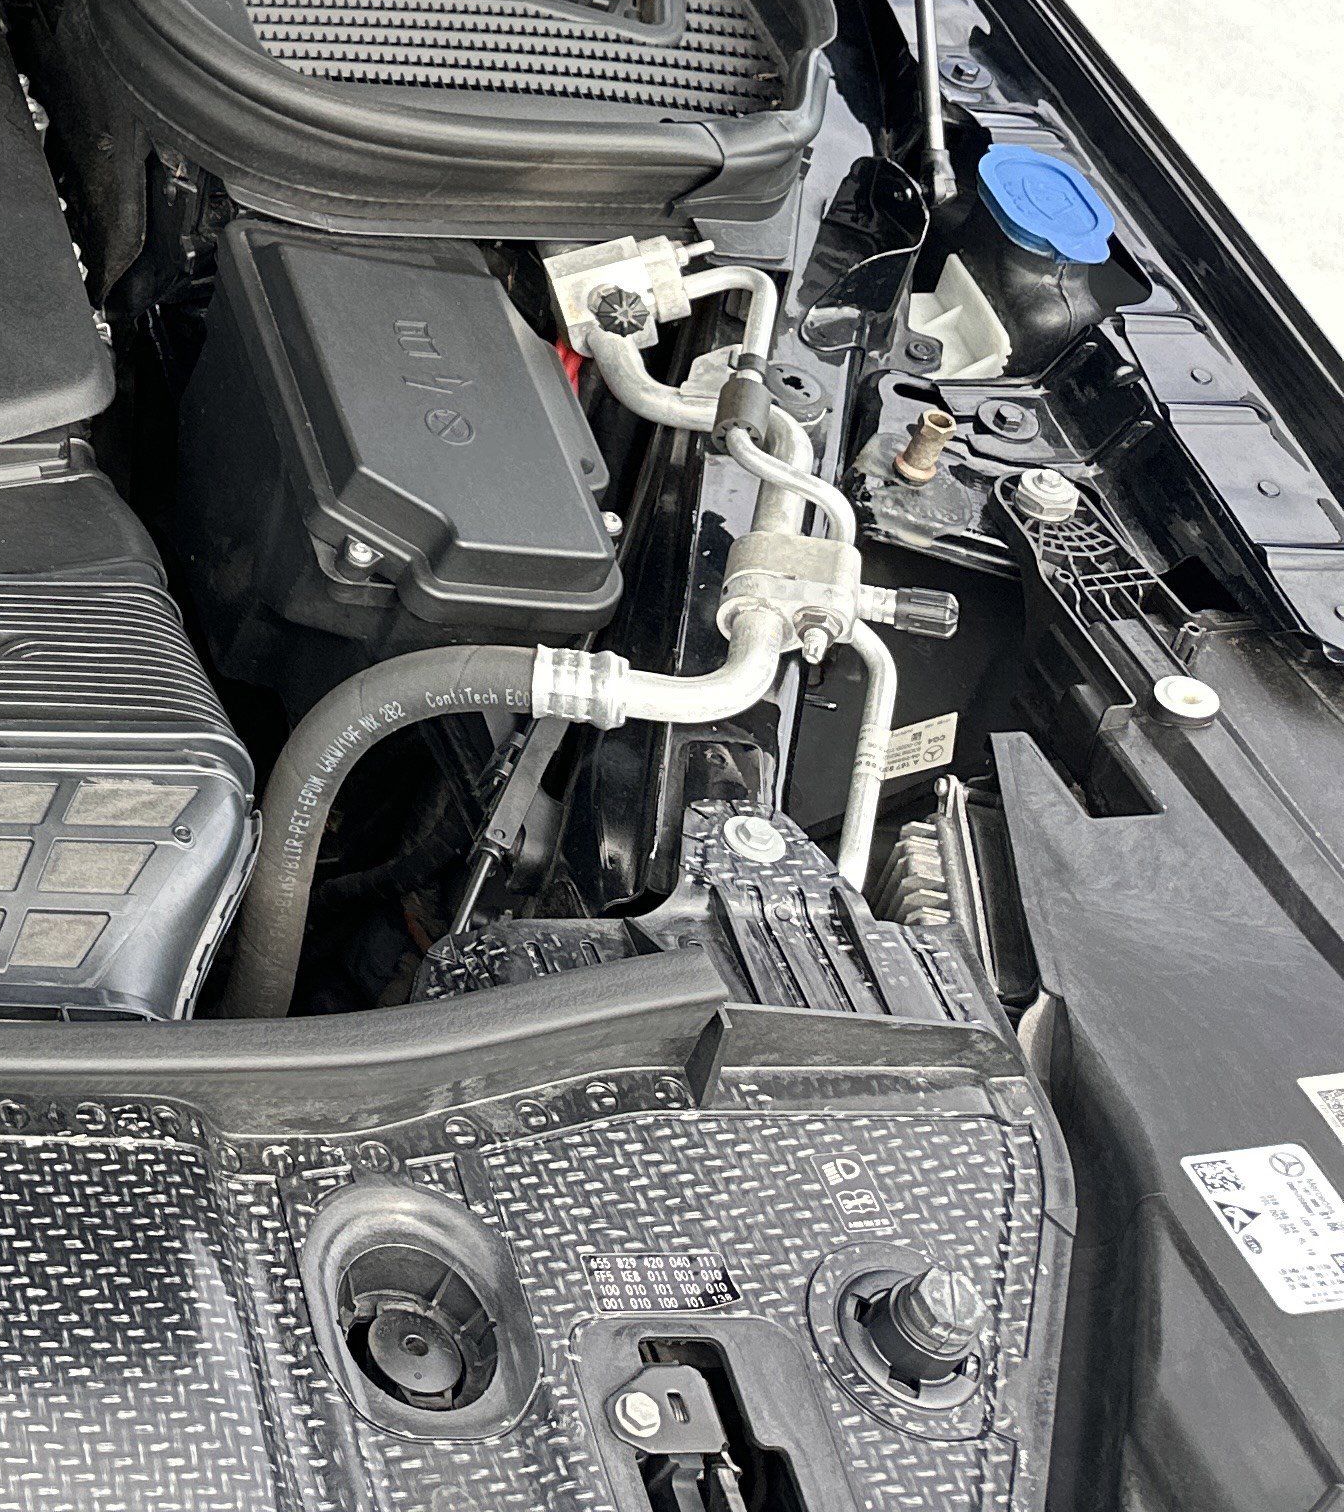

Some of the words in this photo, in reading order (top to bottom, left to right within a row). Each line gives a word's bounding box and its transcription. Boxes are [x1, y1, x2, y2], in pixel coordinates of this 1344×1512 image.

[425, 687, 499, 708] ContiTech
[643, 1257, 664, 1269] 420
[669, 1257, 690, 1268] 040
[697, 1256, 717, 1268] 111
[594, 1271, 614, 1282] FF5
[648, 1271, 668, 1282] 011
[674, 1270, 694, 1282] 001
[701, 1270, 722, 1281] 010
[600, 1285, 619, 1296] 100
[625, 1285, 646, 1296] 010
[653, 1284, 673, 1295] 101
[680, 1283, 700, 1295] 100
[705, 1283, 727, 1294] 010
[603, 1298, 624, 1310] 001
[630, 1298, 651, 1309] 010
[658, 1297, 678, 1309] 100
[685, 1297, 705, 1308] 101
